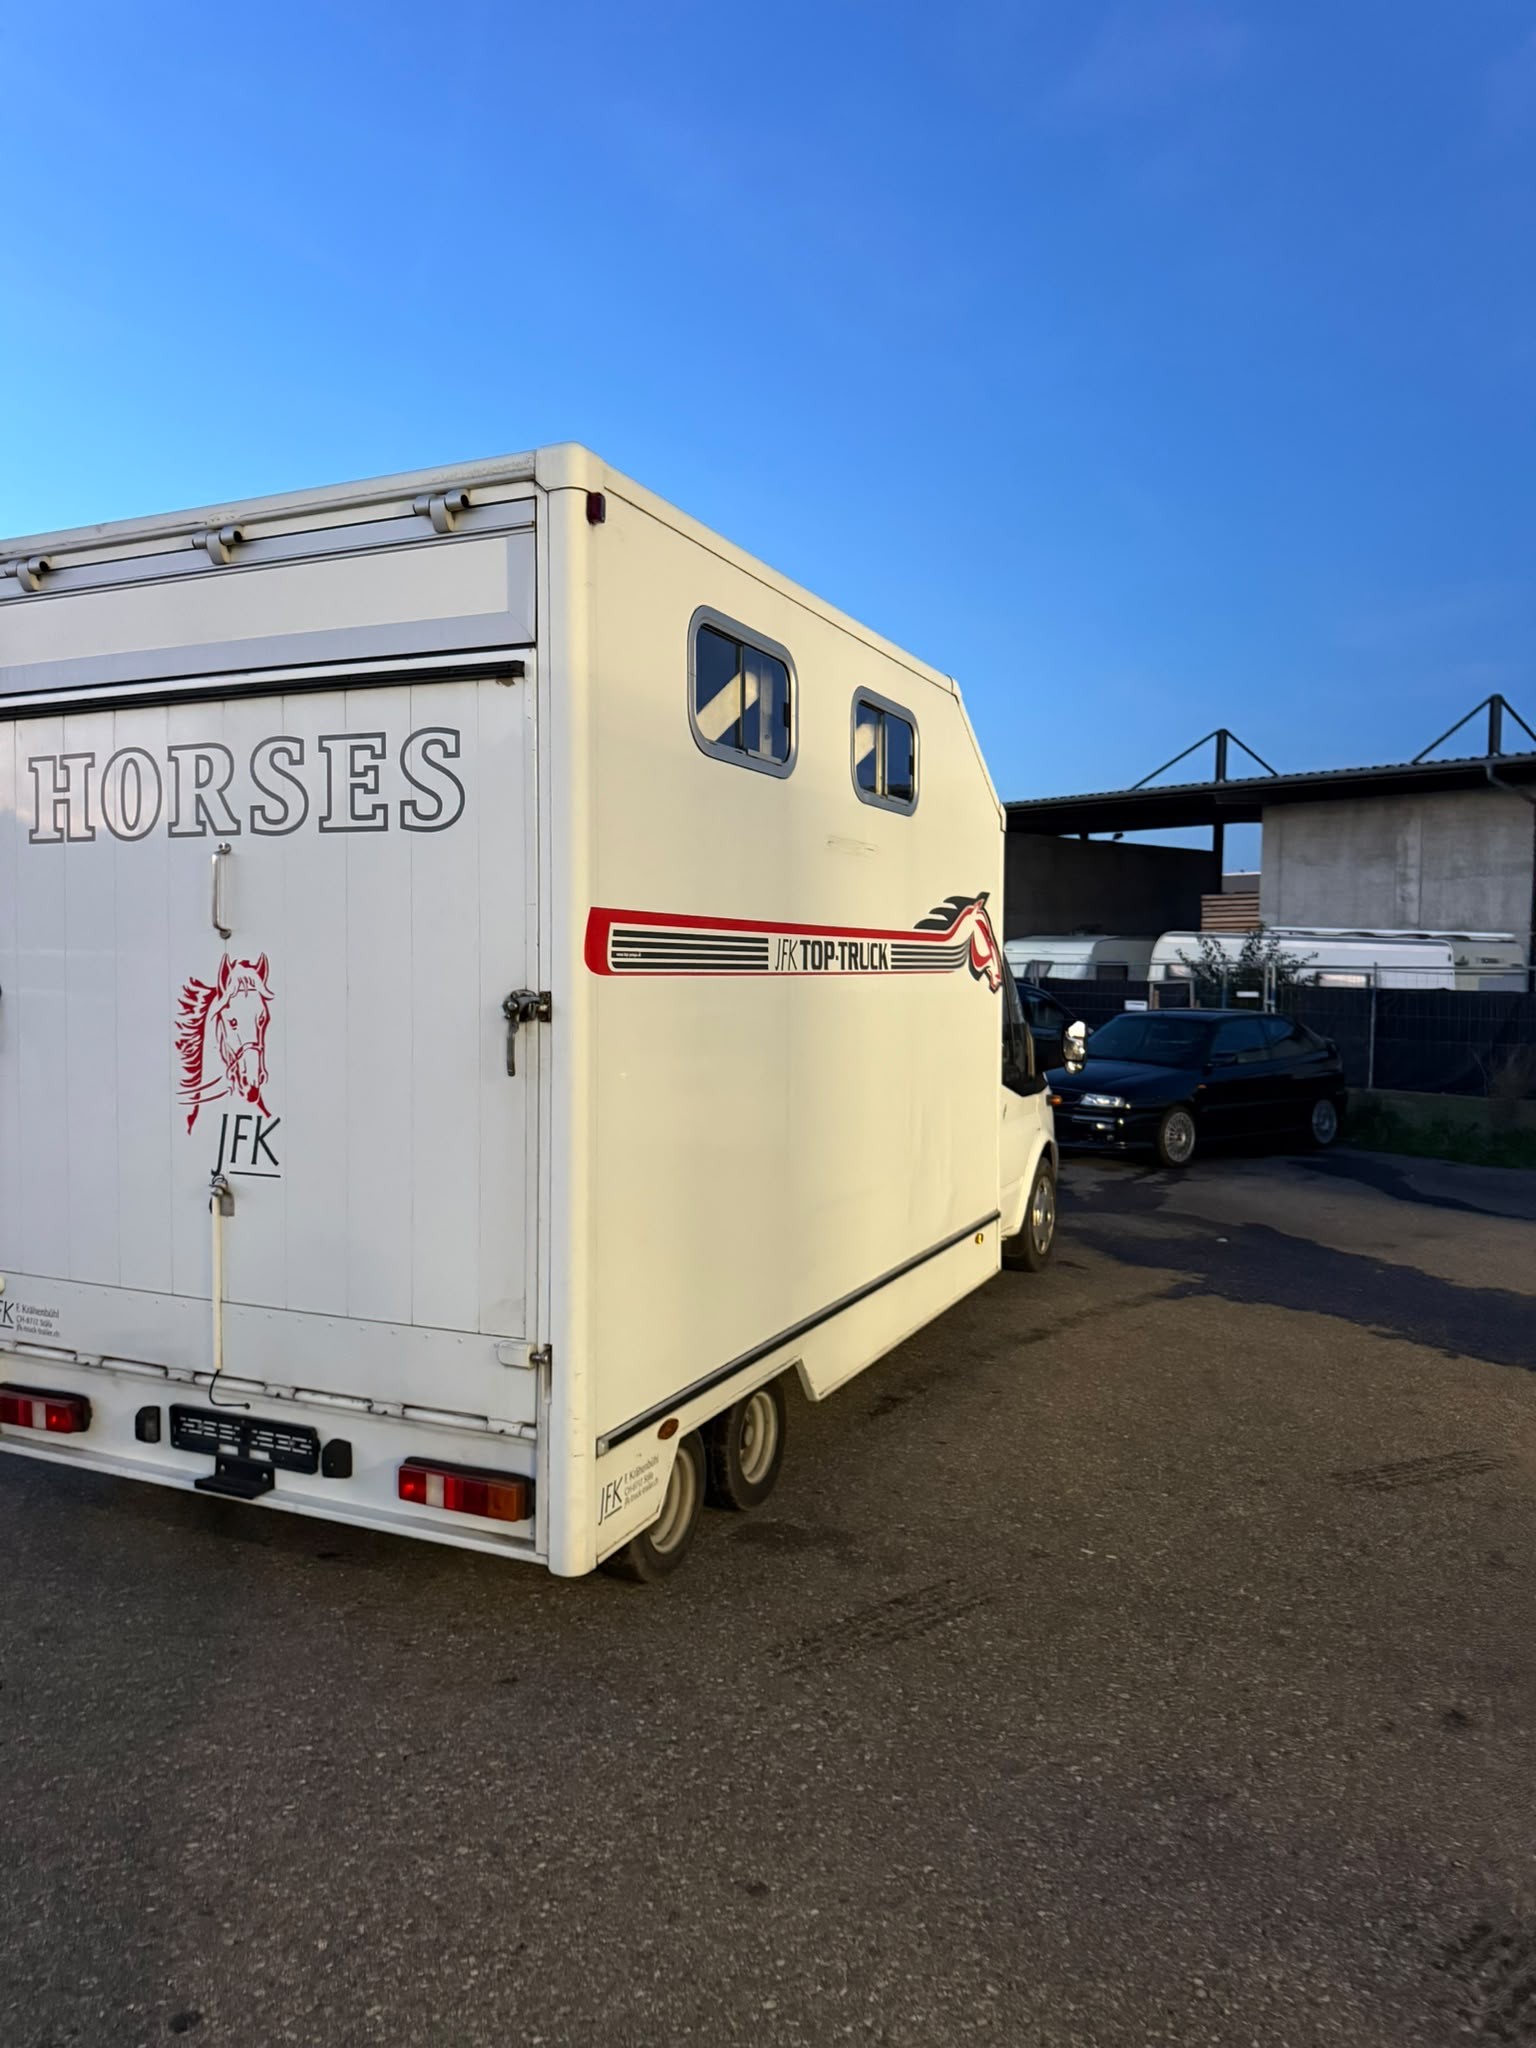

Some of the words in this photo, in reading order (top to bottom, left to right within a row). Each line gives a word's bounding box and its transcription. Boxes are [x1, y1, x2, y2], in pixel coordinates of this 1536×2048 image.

[28, 727, 466, 844] HORSES
[774, 938, 799, 971] JFK
[211, 1113, 281, 1177] JFK
[598, 1476, 623, 1526] JFK
